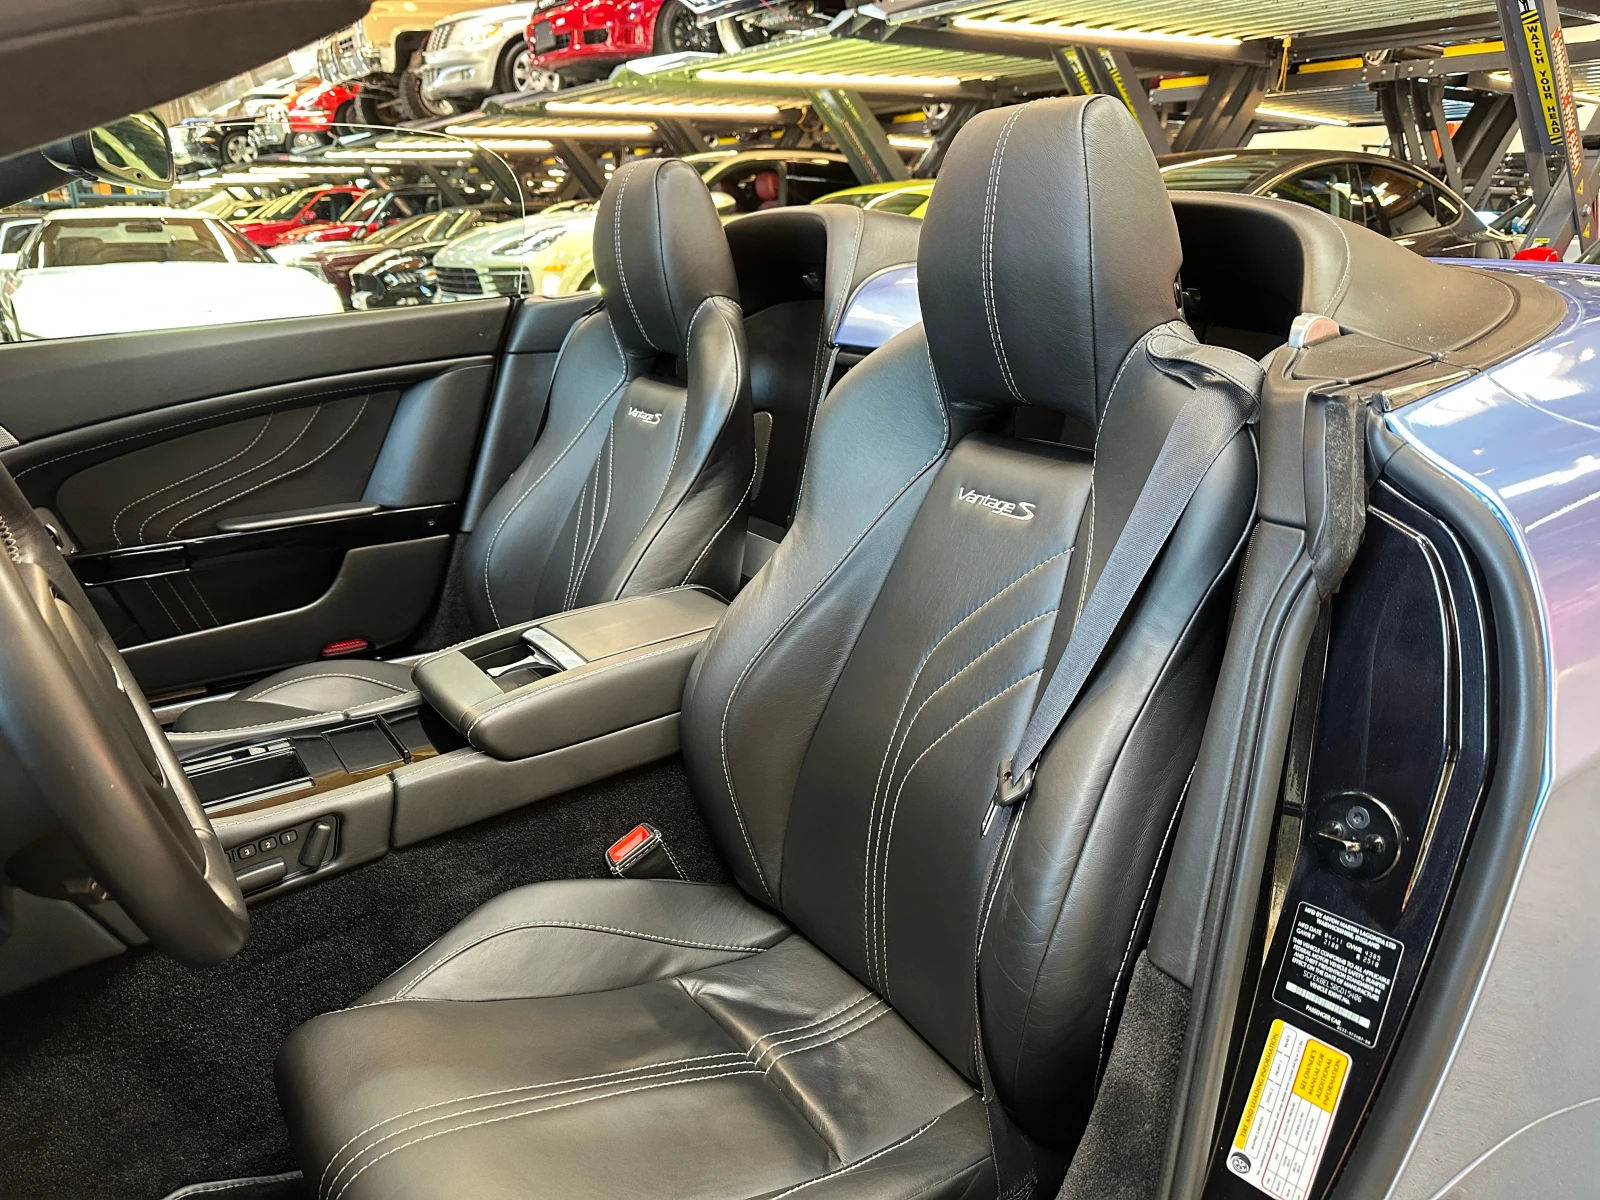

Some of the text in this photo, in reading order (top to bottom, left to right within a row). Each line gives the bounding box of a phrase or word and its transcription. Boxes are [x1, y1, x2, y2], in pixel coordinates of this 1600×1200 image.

[1527, 25, 1561, 134] WATCH YOUR HEAD
[957, 487, 1016, 515] Vantage
[1309, 926, 1322, 936] DATE
[1346, 942, 1362, 953] GVWR
[1322, 914, 1339, 925] ASTON
[1339, 921, 1359, 934] MARTIN
[1359, 929, 1385, 945] LAGONDA
[1385, 940, 1396, 949] LTD
[1354, 934, 1380, 949] ENGLAND
[1293, 951, 1304, 960] AND
[1302, 941, 1320, 953] VEHICLE
[1354, 964, 1362, 972] ALL
[1362, 968, 1390, 984] APPLICABLE
[1311, 952, 1329, 964] MOTOR
[1329, 960, 1348, 973] VEHICLE
[1362, 956, 1379, 968] 2510
[1310, 981, 1328, 994] VEHICLE
[1324, 971, 1336, 982] DATE
[1305, 1004, 1341, 1026] PASSENGER CAR
[1303, 1050, 1316, 1079] OWNER'S
[1315, 1058, 1332, 1099] ADDITIONAL
[1240, 1124, 1248, 1136] TIRE
[1250, 1078, 1264, 1108] LOADING
[1260, 1033, 1278, 1077] INFORMATION
[1307, 1067, 1320, 1095] MANUAL
[1323, 1060, 1341, 1105] INFORMATION
